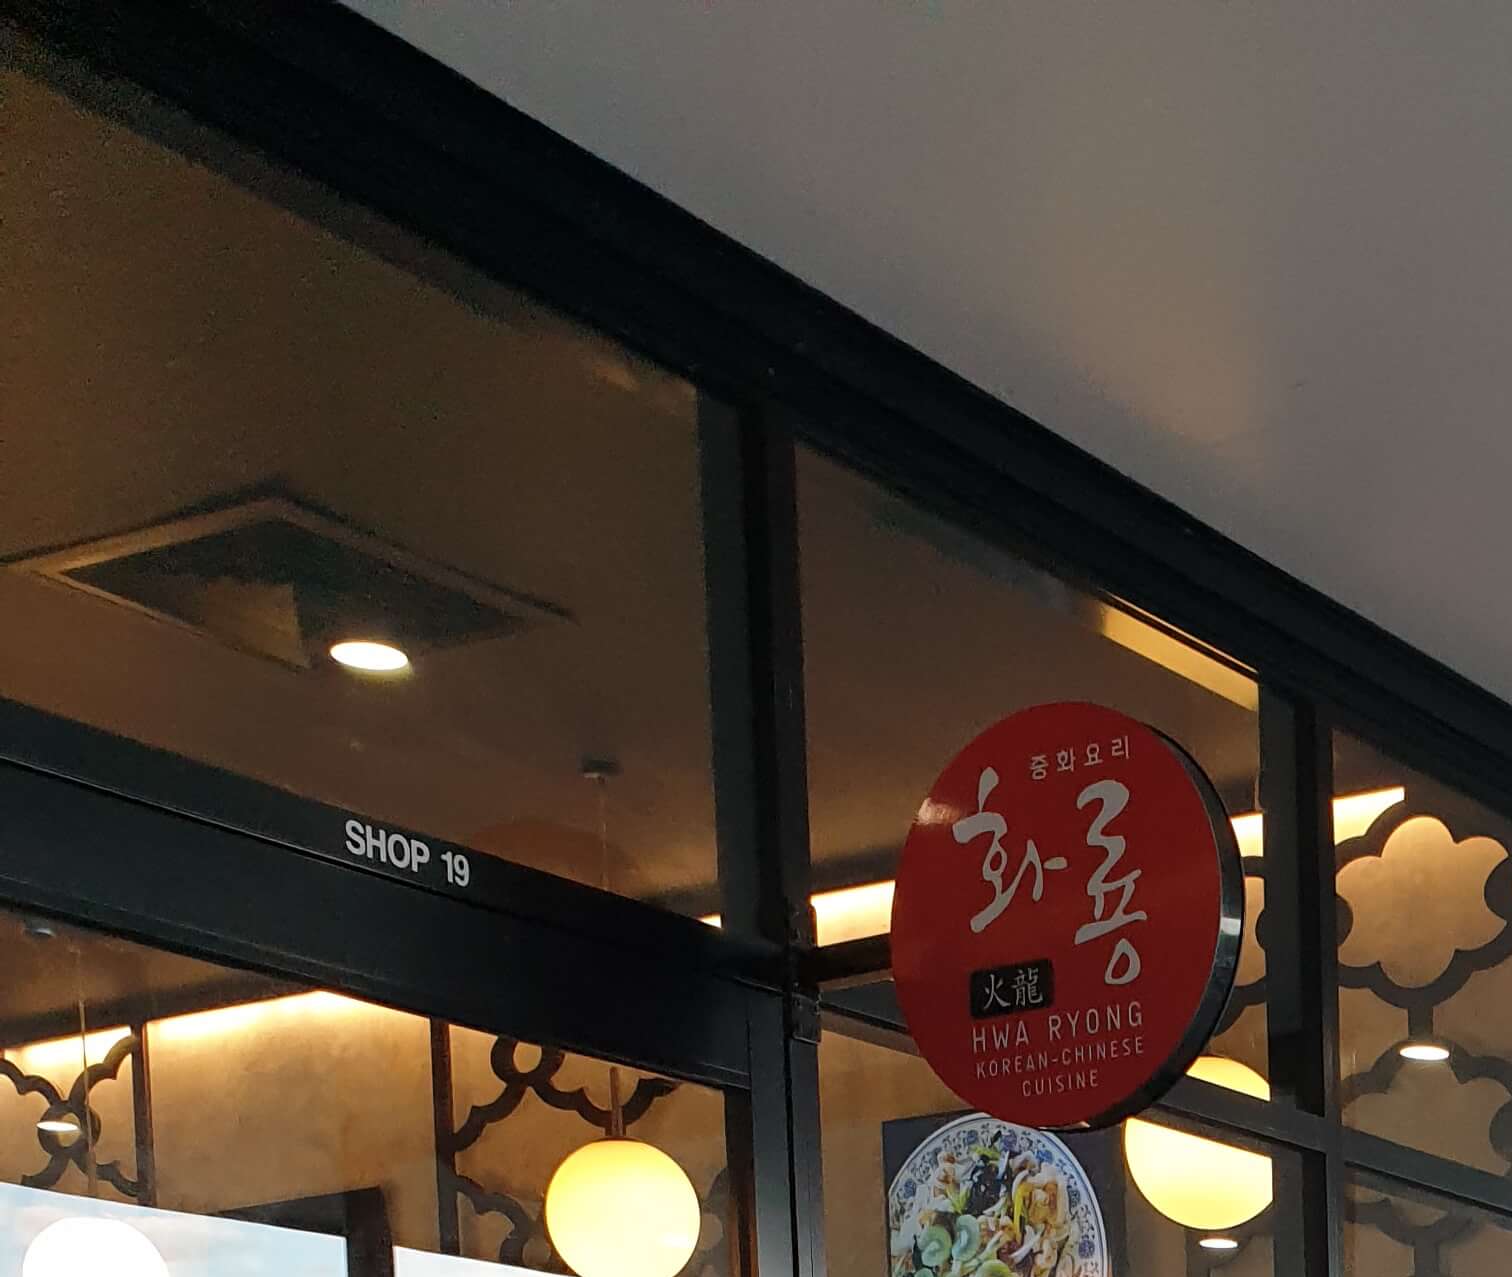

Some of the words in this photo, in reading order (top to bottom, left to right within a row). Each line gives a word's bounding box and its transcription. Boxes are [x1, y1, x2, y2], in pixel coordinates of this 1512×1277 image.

[1029, 735, 1130, 781] 중화요리
[345, 819, 430, 873] SHOP
[440, 851, 470, 887] 19
[952, 765, 1148, 986] 화룡
[983, 967, 1044, 1012] 火龍
[972, 1019, 1030, 1055] HWA
[1047, 1001, 1143, 1041] RYONG
[975, 1035, 1145, 1079] KOREAN-CHINESE
[1021, 1068, 1099, 1097] CUISINE
